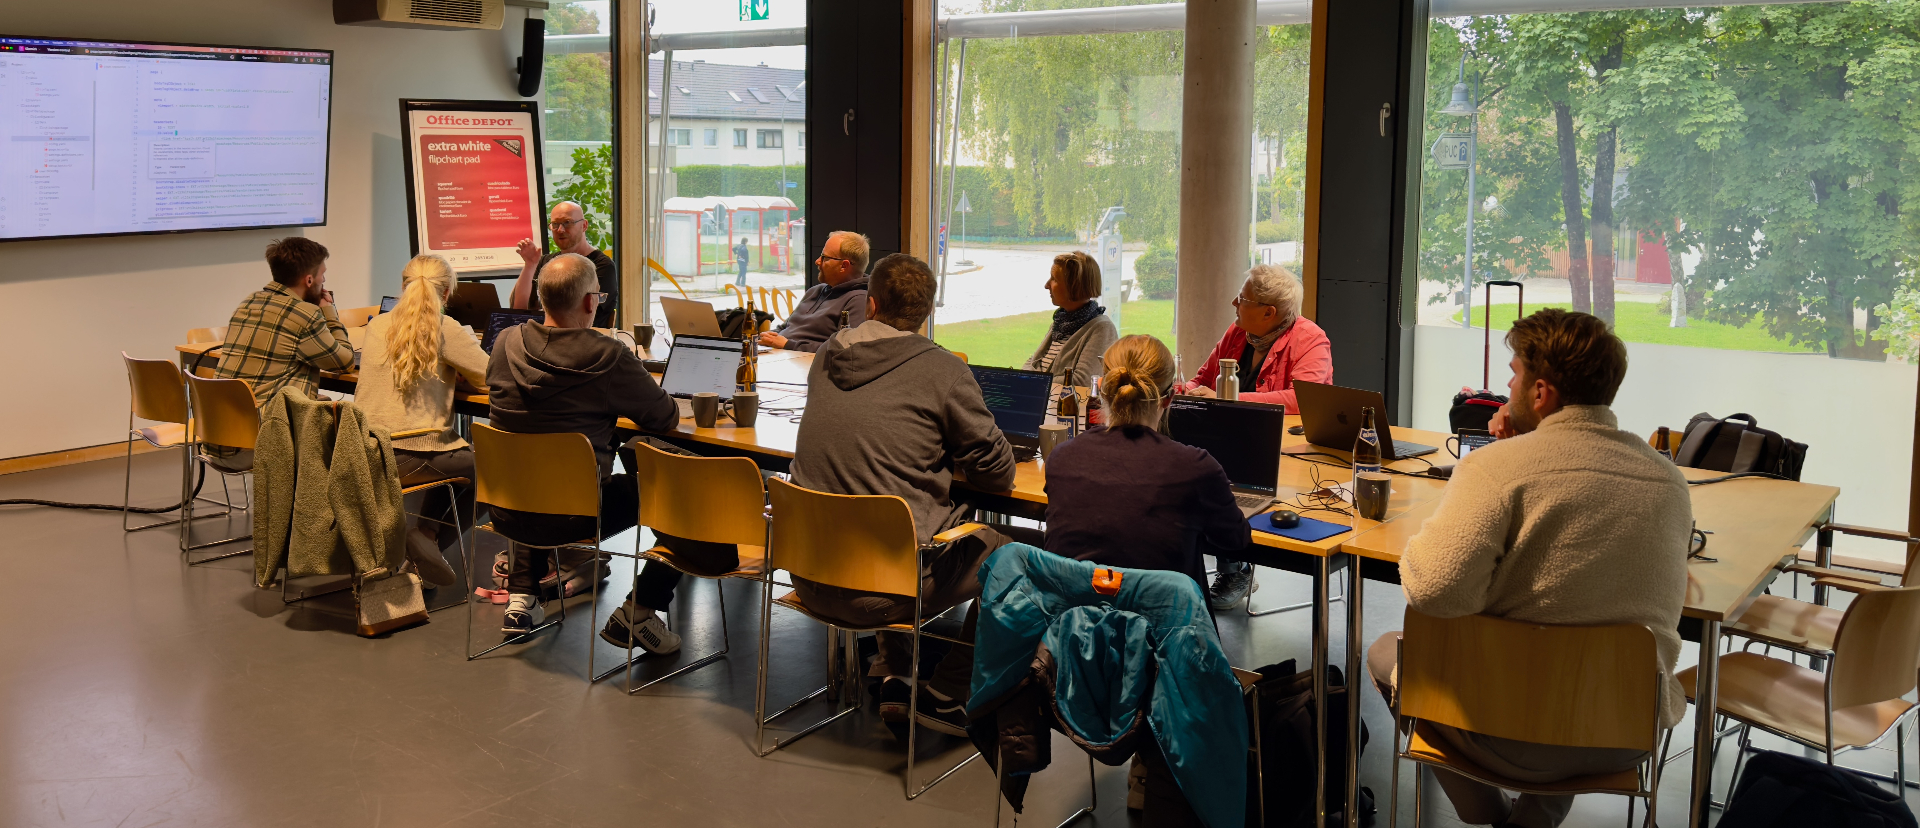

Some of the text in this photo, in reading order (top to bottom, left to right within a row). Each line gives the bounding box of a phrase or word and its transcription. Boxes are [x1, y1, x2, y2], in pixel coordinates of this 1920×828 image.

[426, 115, 514, 126] Office DEPOT
[428, 142, 457, 151] extra
[459, 141, 491, 151] white
[429, 155, 480, 165] flipchart pad
[639, 626, 661, 648] PUMA
